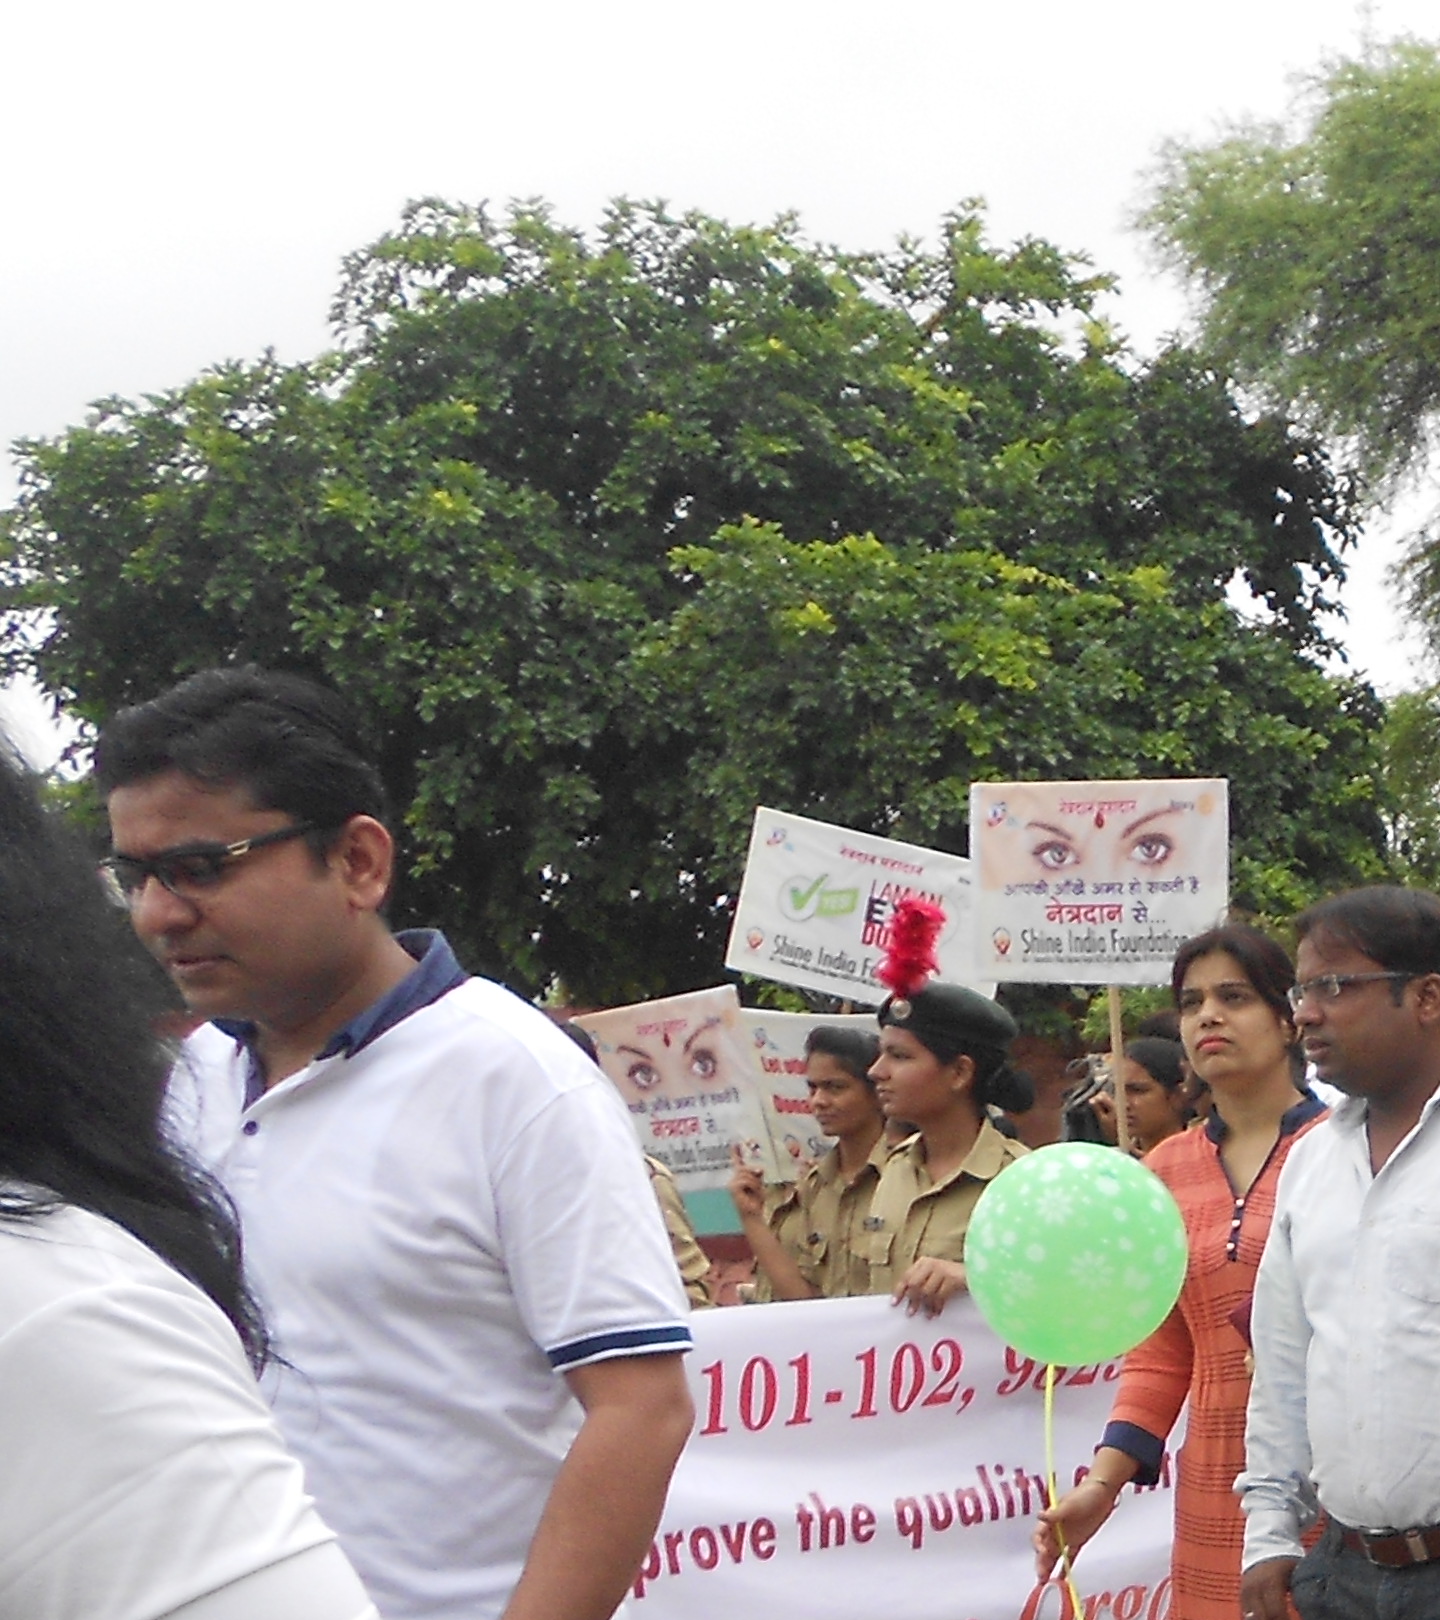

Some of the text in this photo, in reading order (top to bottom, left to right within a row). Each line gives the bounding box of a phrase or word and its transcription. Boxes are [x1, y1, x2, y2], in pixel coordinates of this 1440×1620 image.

[1045, 896, 1123, 924] नेत्रदान
[773, 933, 812, 964] Shine
[817, 946, 857, 975] India
[1020, 927, 1189, 954] Shine India Foundatio
[700, 1338, 974, 1436] 101-102,
[797, 1492, 877, 1552] the
